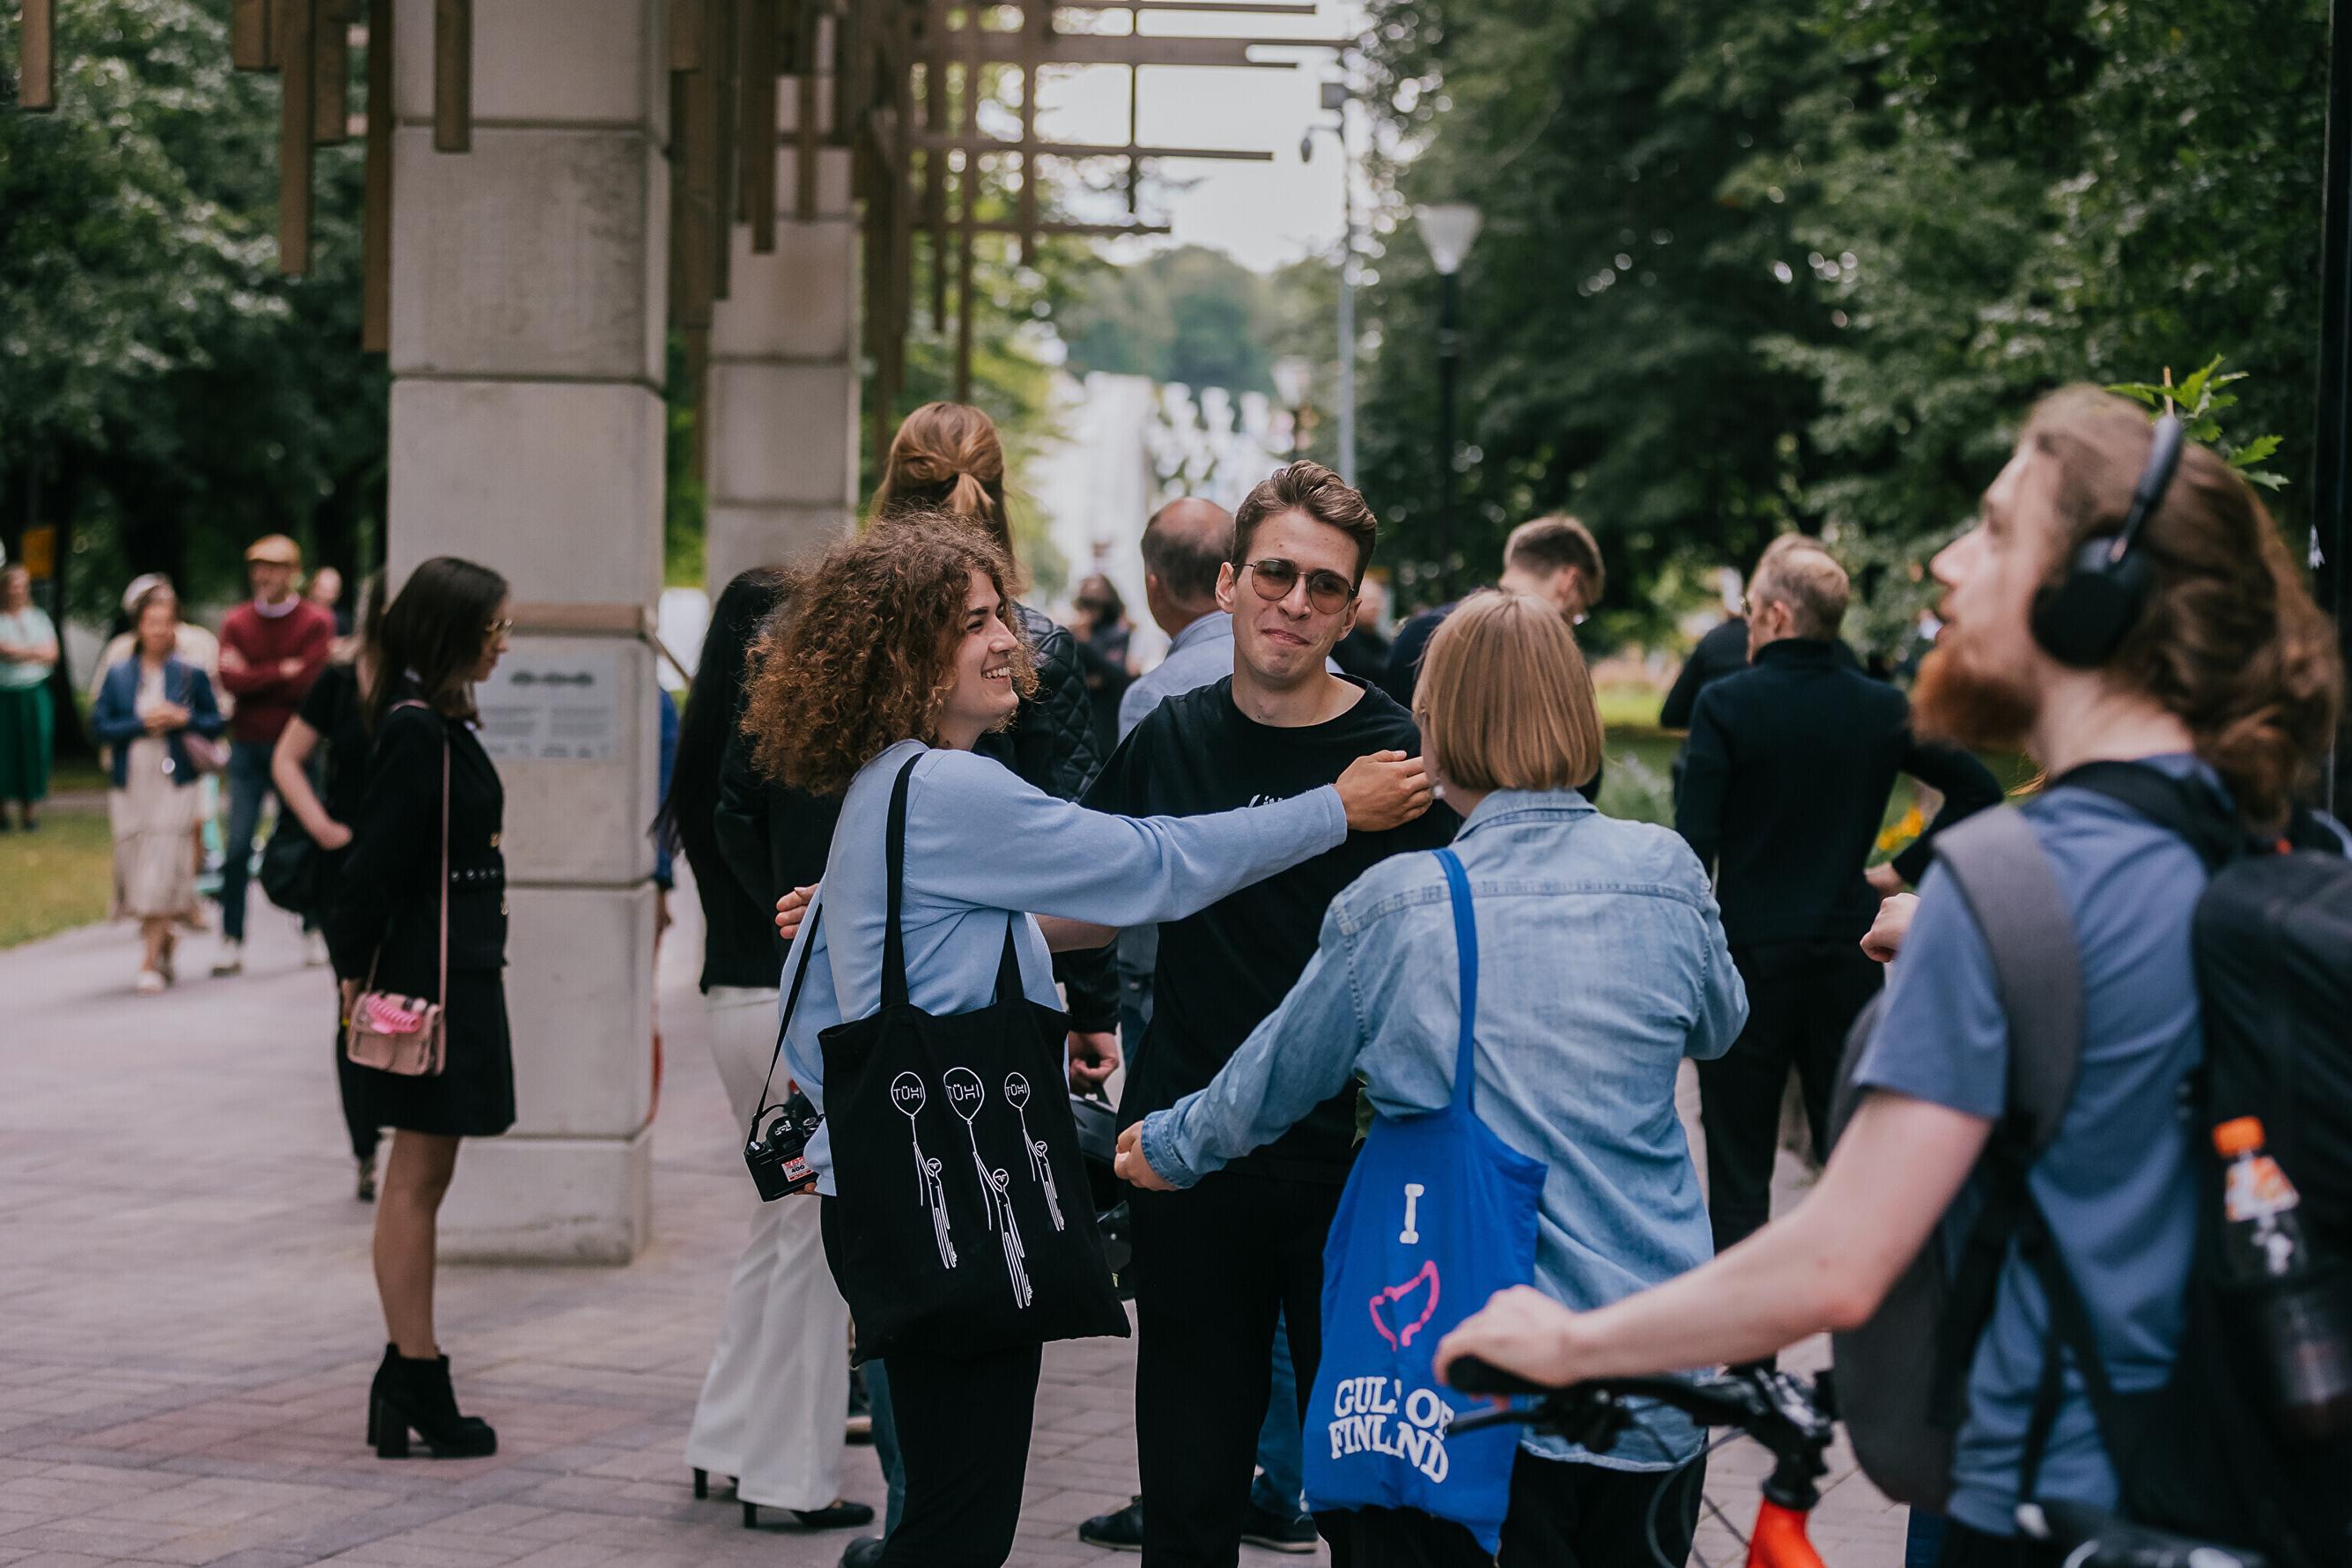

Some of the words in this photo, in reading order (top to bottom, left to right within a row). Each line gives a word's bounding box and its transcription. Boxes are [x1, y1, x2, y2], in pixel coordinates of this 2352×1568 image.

[1399, 1183, 1424, 1244] I
[1335, 1376, 1402, 1417] GUL
[1328, 1414, 1449, 1484] FINLND
